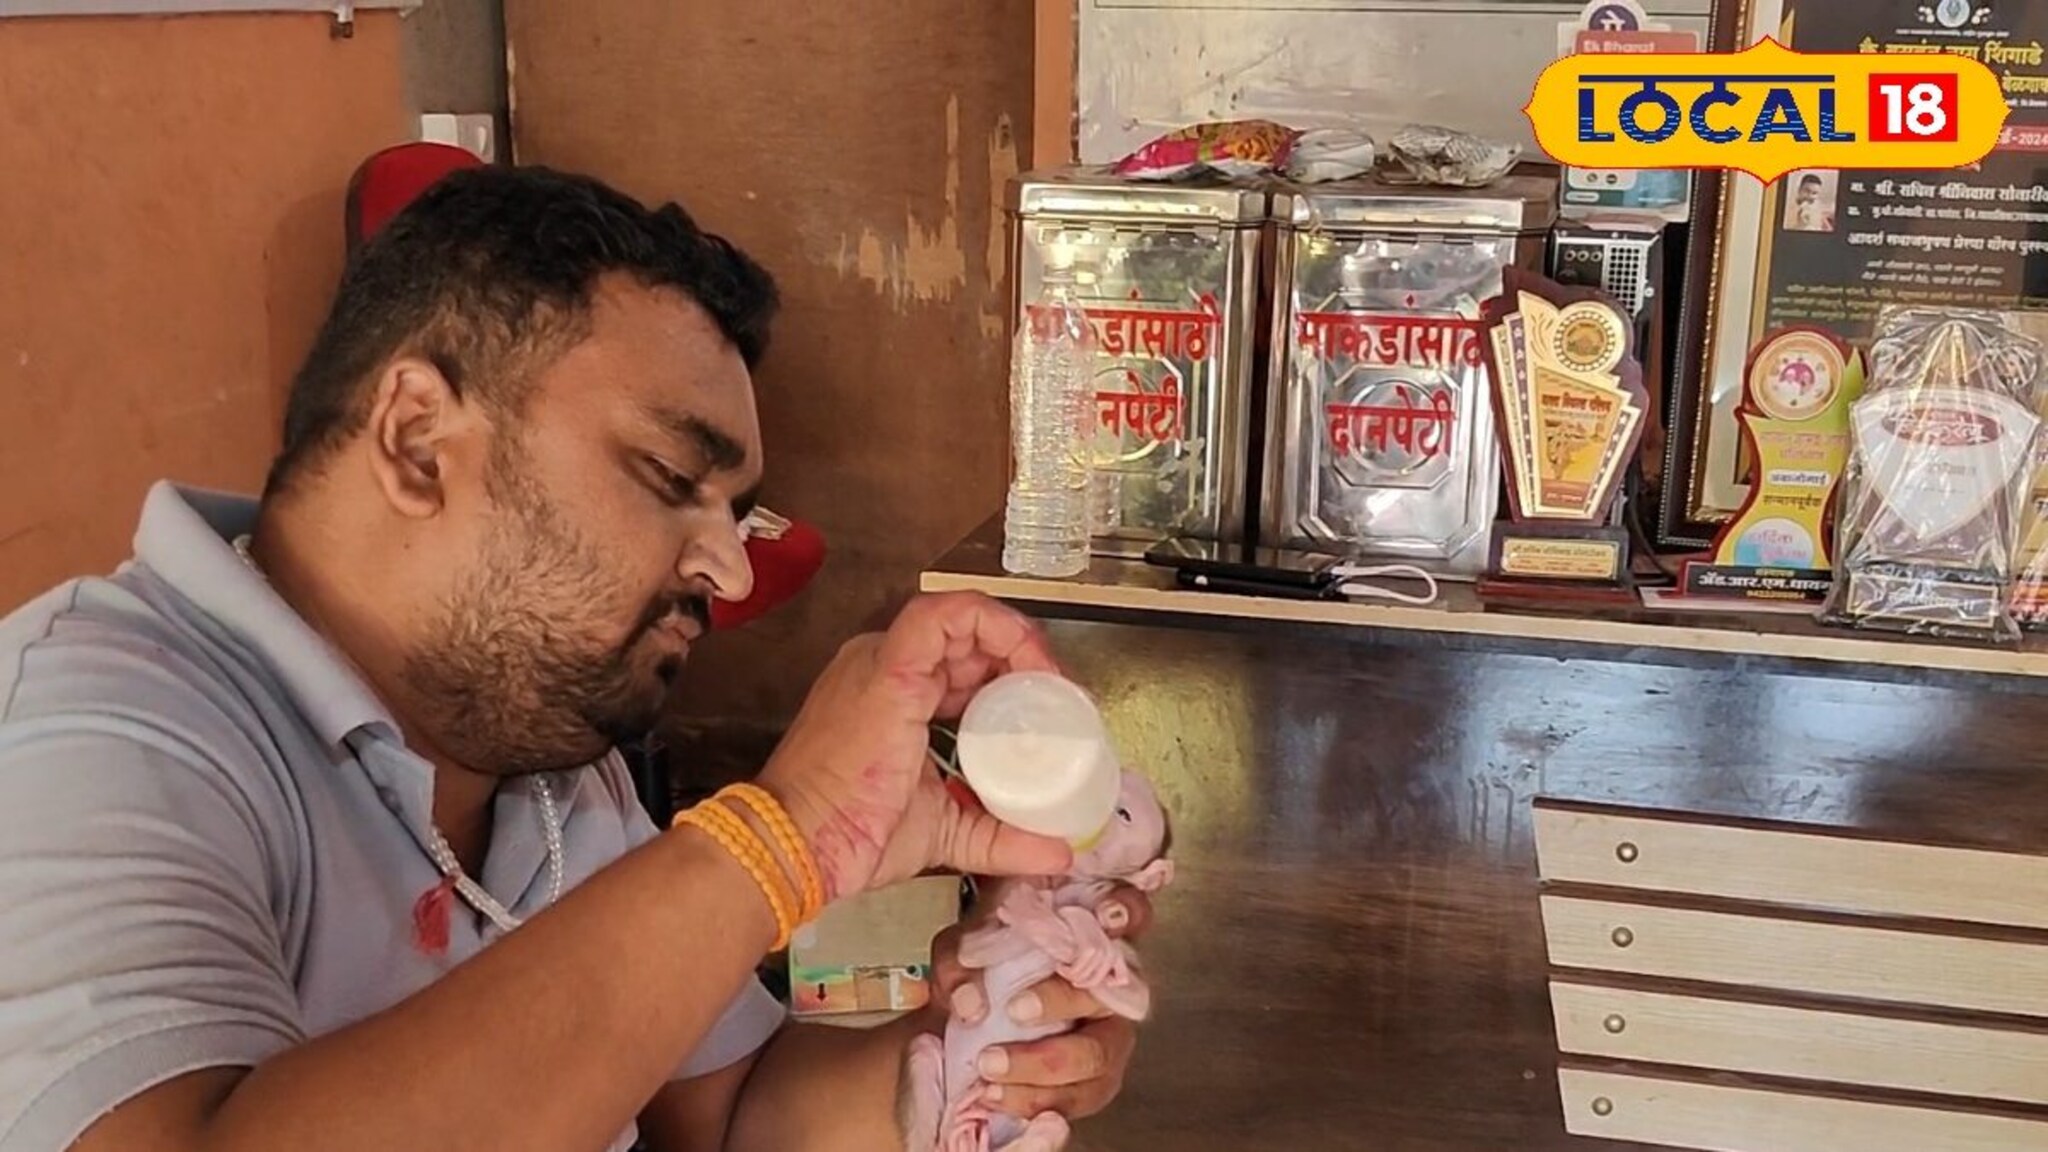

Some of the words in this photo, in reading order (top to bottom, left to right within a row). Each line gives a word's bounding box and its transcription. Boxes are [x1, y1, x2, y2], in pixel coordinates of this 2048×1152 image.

[1297, 294, 1484, 368] माकडांसाठ
[1068, 371, 1184, 442] नपेटी
[1327, 386, 1456, 455] दानपेटी
